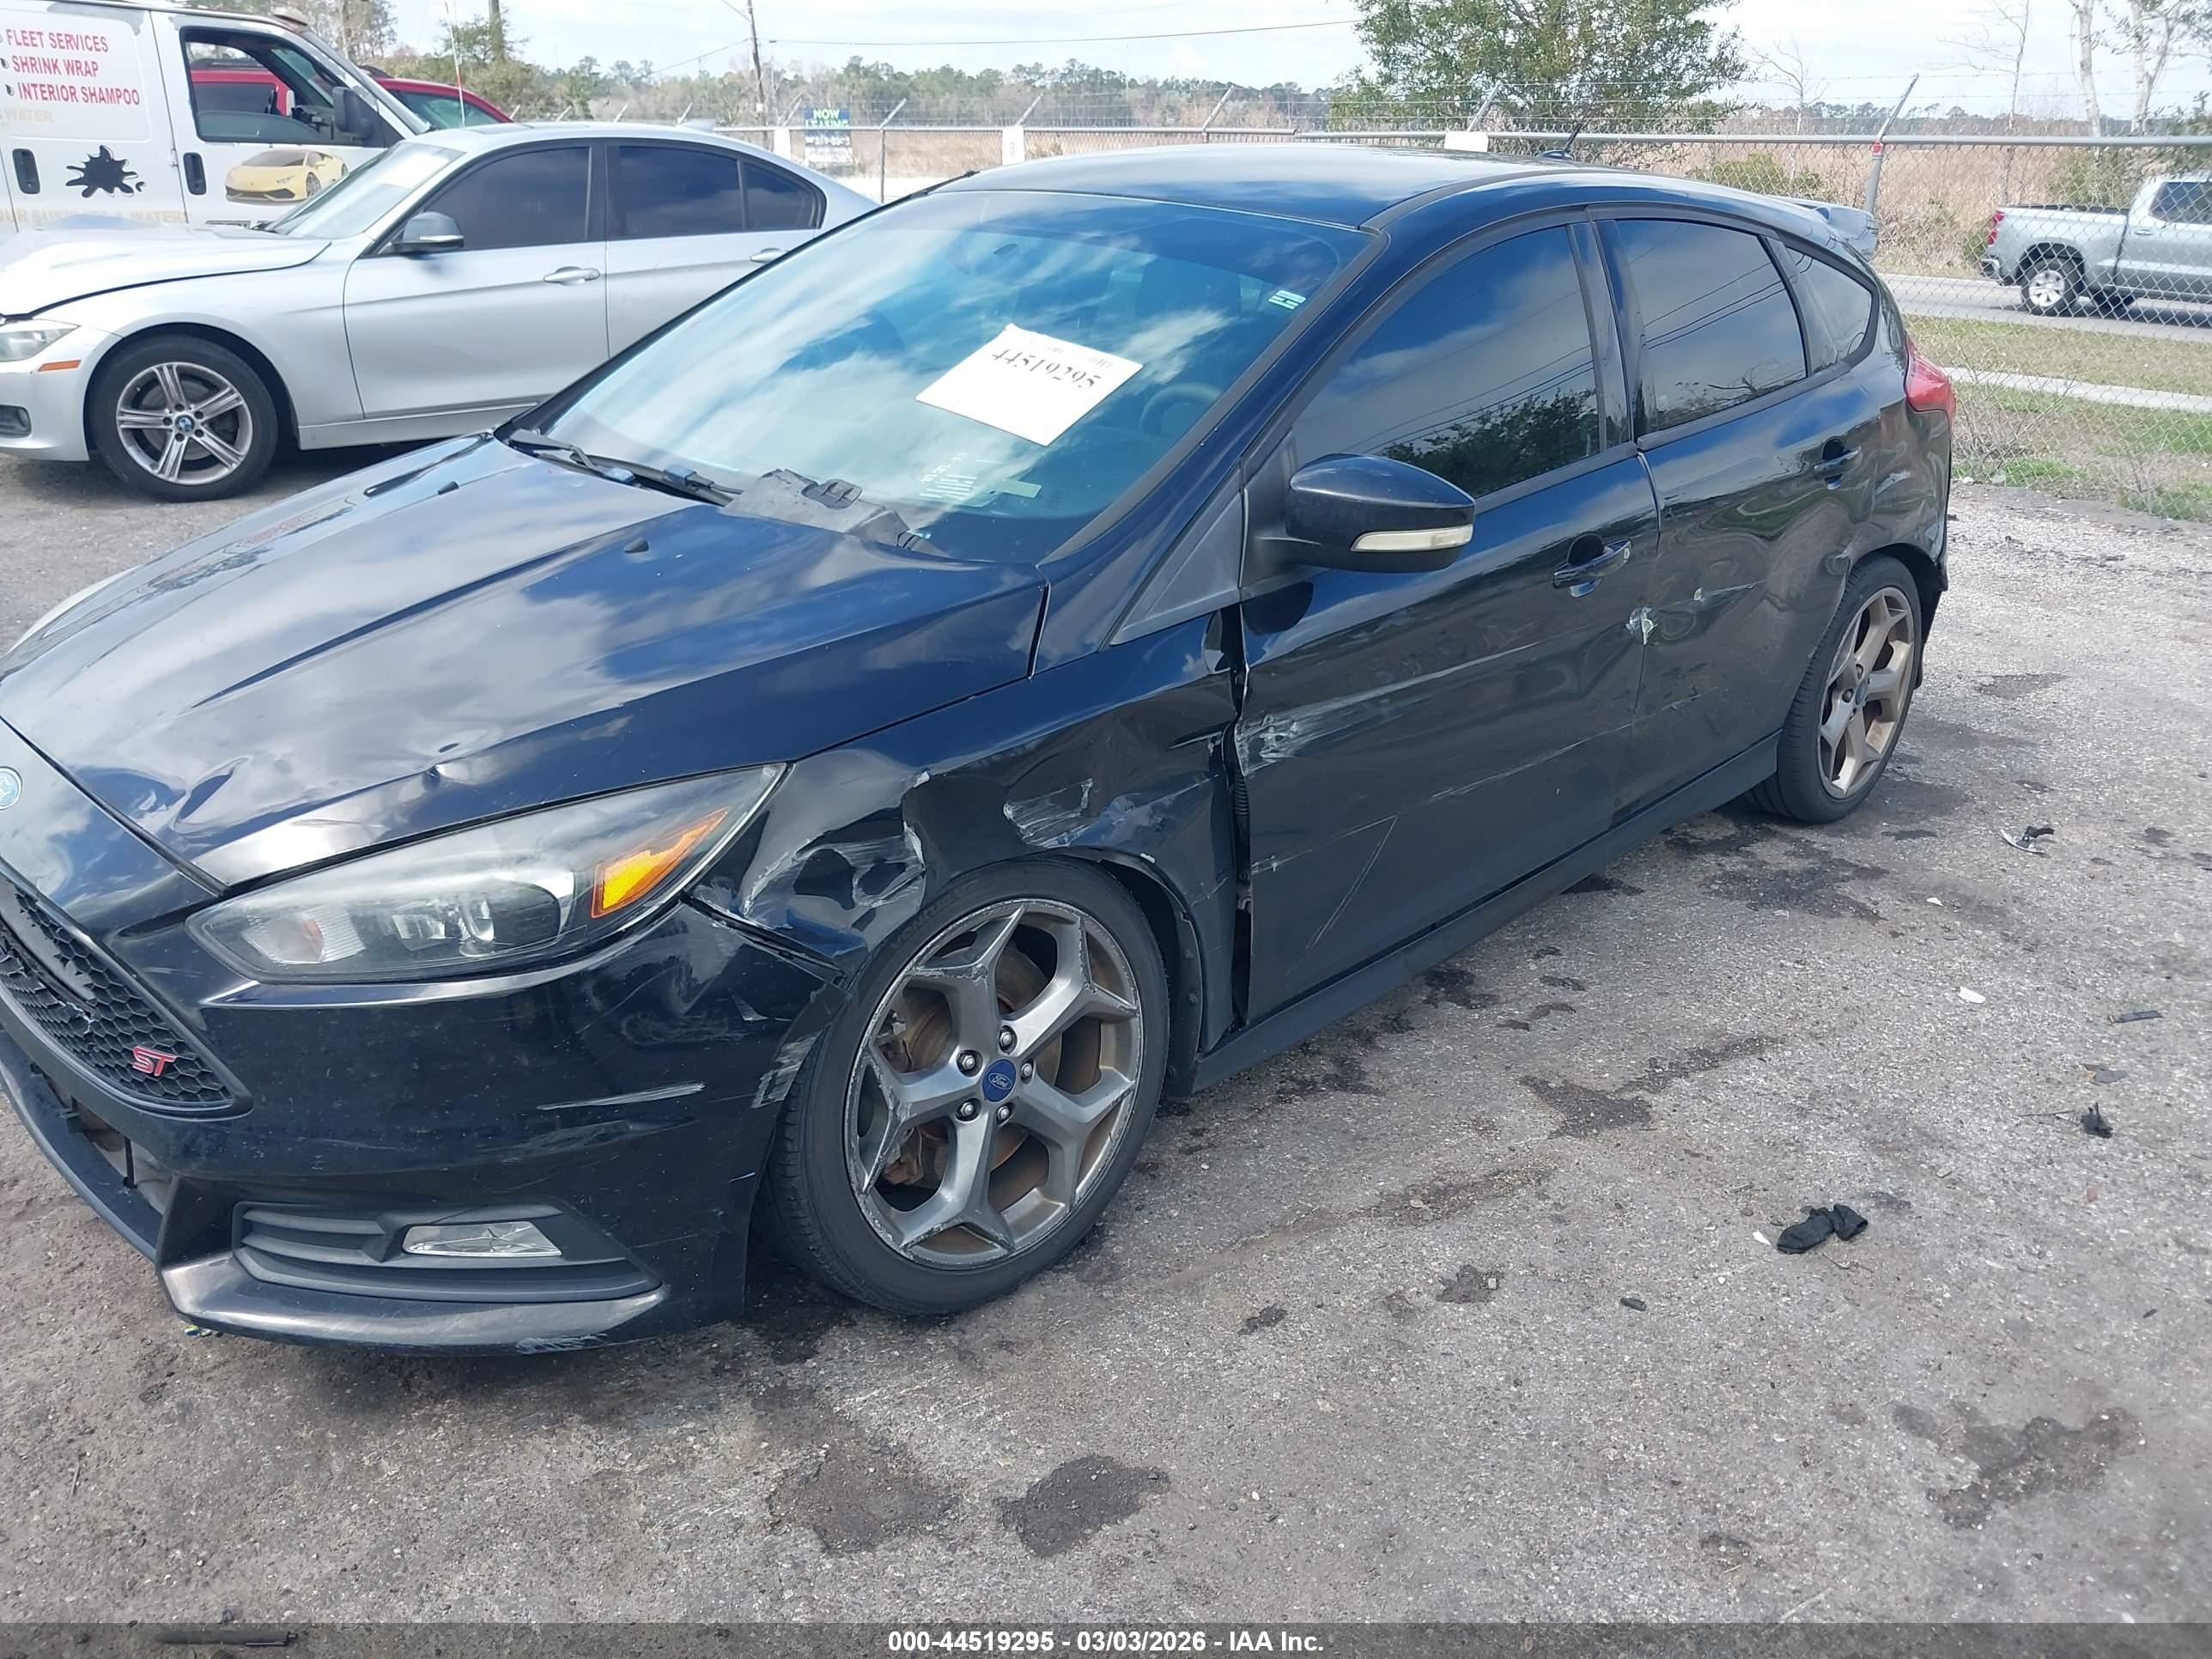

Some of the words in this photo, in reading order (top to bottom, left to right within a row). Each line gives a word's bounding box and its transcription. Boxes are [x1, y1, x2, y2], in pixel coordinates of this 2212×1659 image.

[6, 29, 44, 48] FLEET
[49, 33, 108, 52] SERVICES
[12, 55, 62, 75] SHRINK
[64, 58, 99, 77] WRAP
[17, 82, 79, 102] INTERIOR
[81, 86, 140, 106] SHAMPOO
[813, 109, 840, 119] NOW
[992, 349, 1102, 388] 44519295
[132, 1046, 177, 1077] ST
